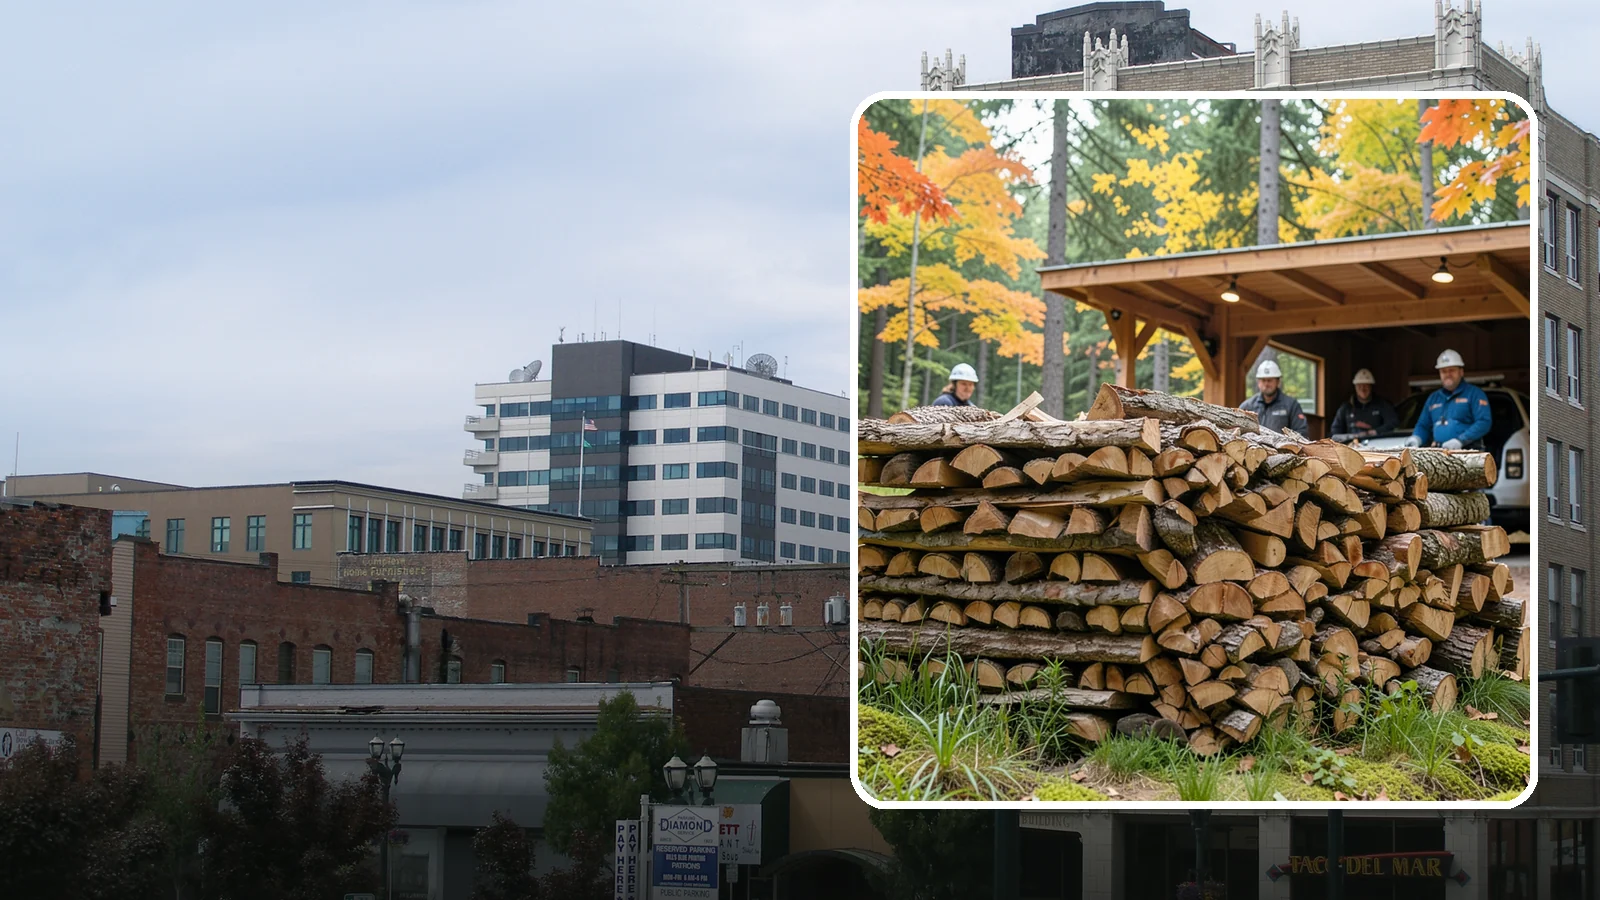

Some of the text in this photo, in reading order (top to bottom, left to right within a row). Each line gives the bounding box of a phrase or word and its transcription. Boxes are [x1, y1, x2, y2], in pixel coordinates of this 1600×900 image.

[343, 566, 427, 577] Home Furnishers
[660, 818, 713, 833] DIAMOND
[1022, 815, 1069, 828] BUILDING
[719, 824, 740, 835] ETT
[656, 845, 716, 854] RESERVED PARKING
[719, 839, 740, 849] ANT
[617, 824, 625, 894] PAY HERE
[627, 824, 637, 894] PAY HERE
[671, 862, 701, 870] PATRONS
[1290, 855, 1442, 877] TAC DEL MAR
[660, 888, 710, 898] PUBLIC PARKING
